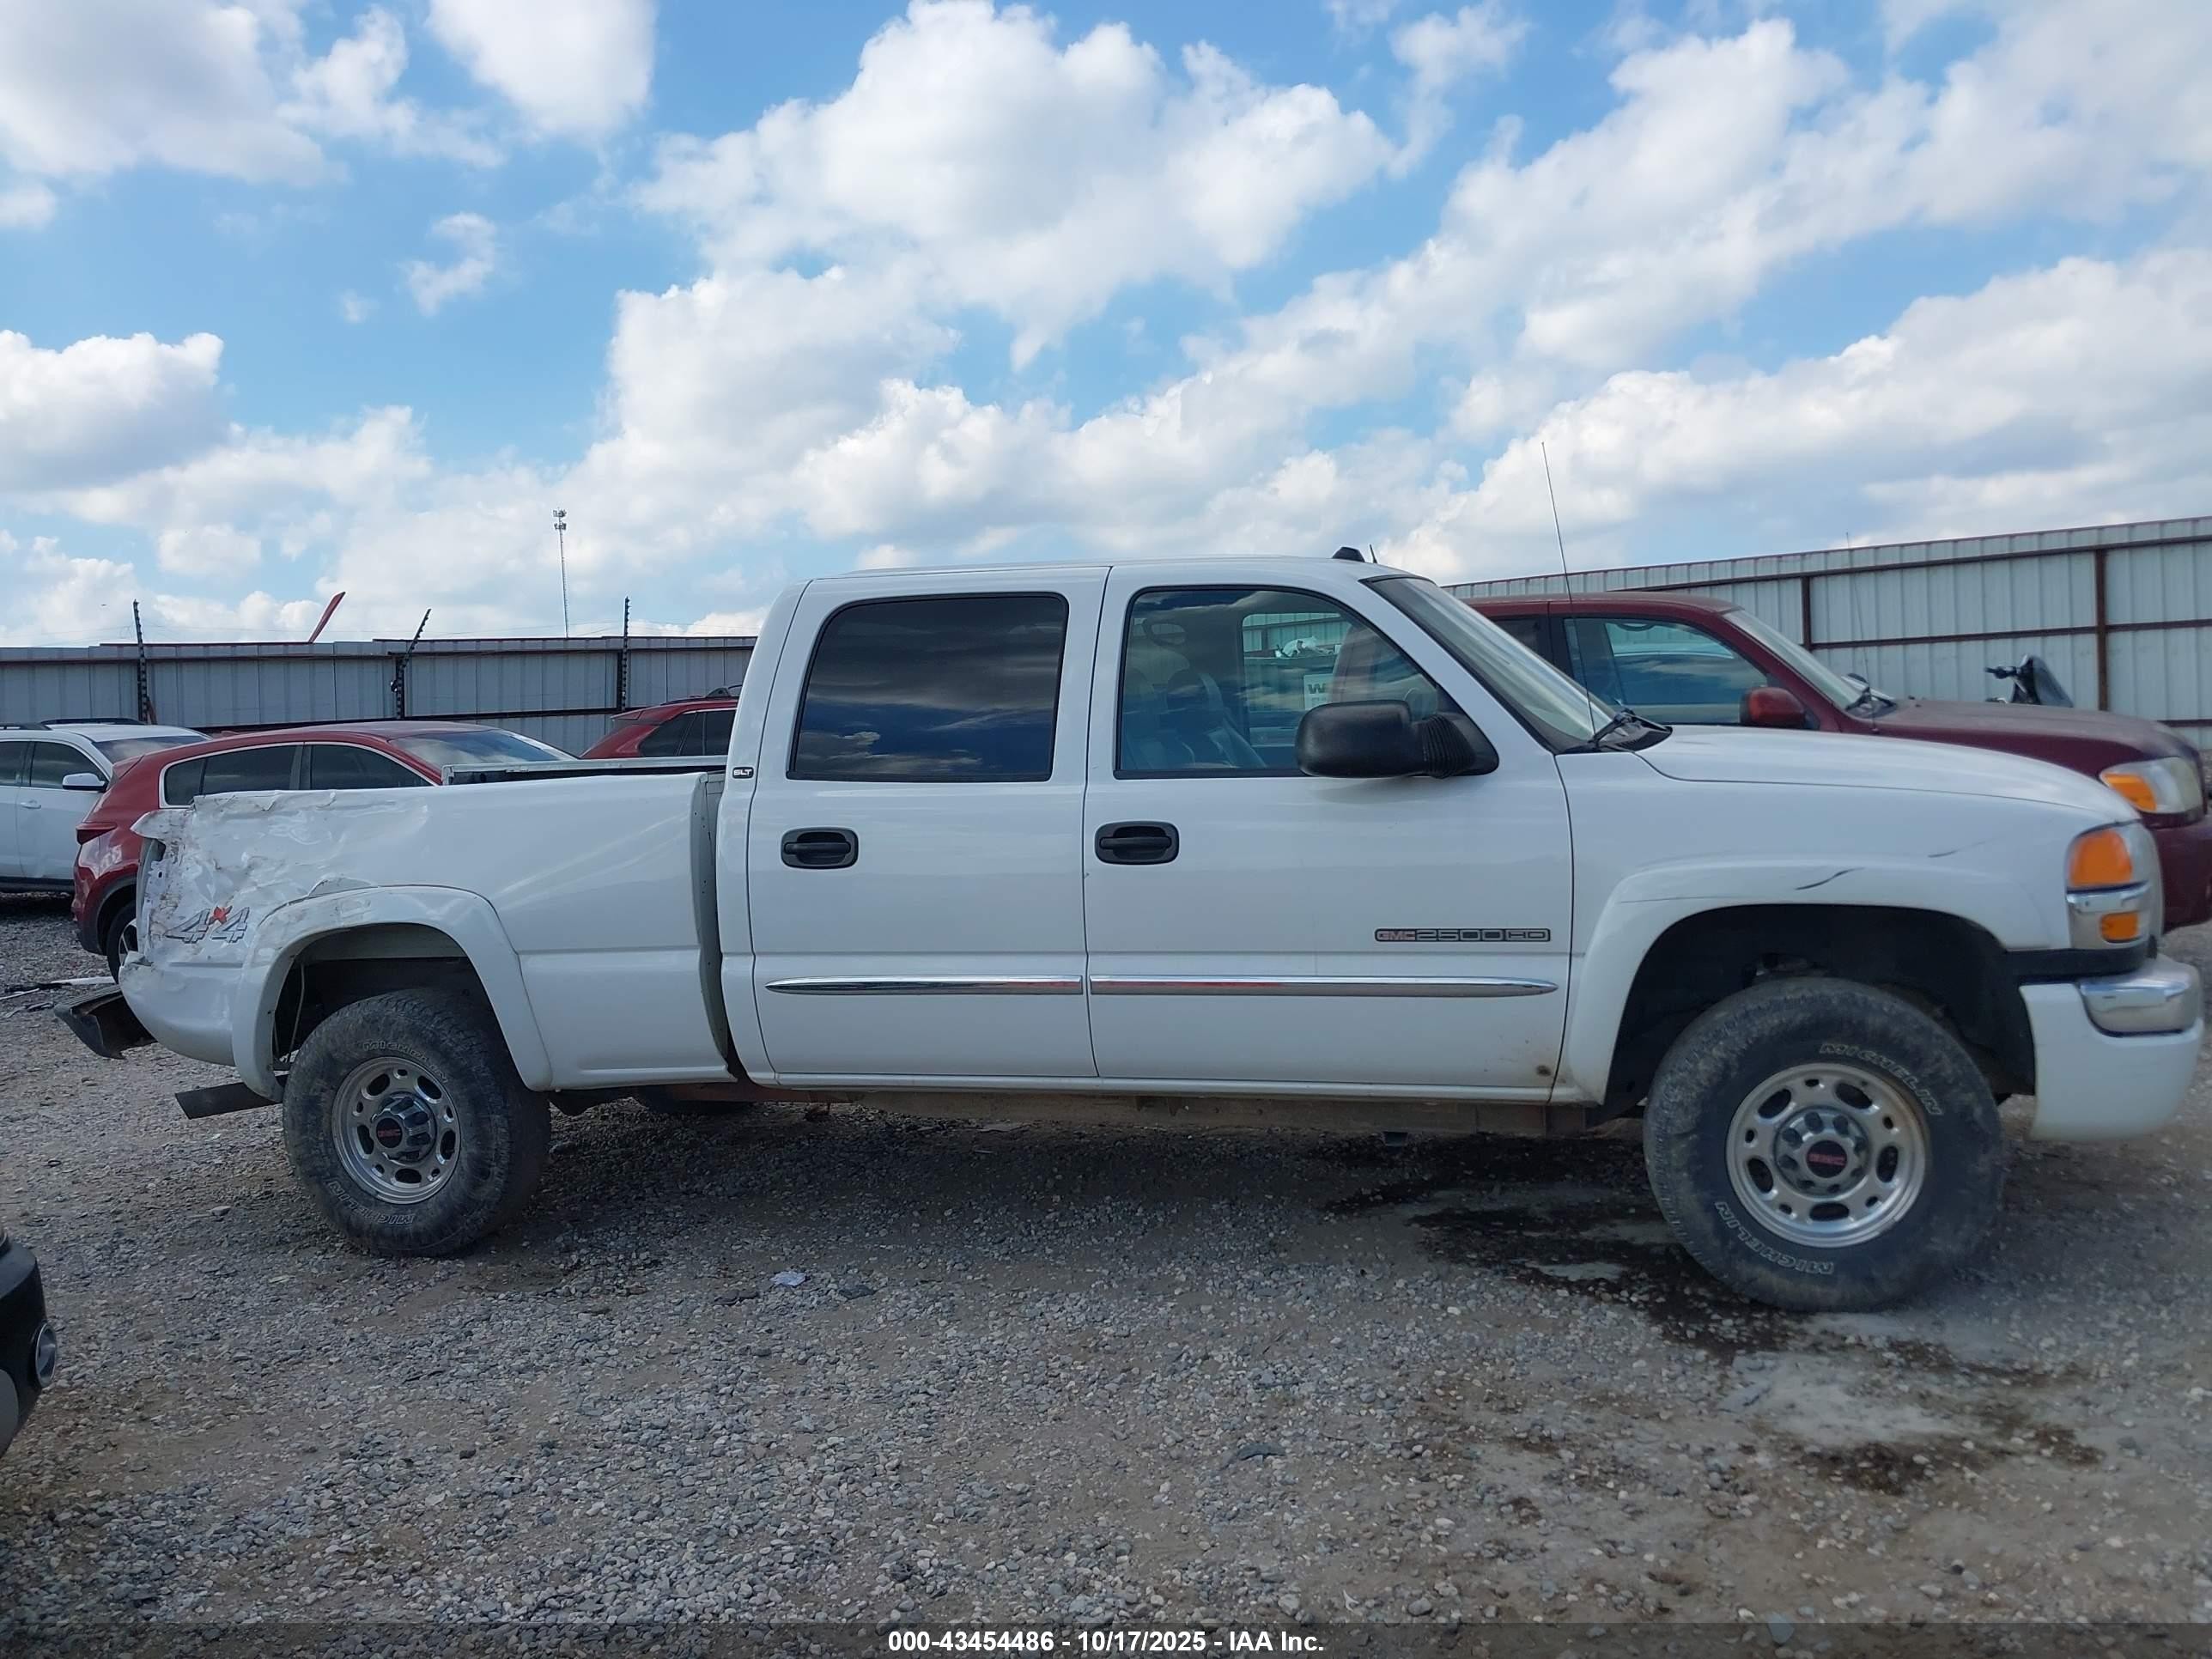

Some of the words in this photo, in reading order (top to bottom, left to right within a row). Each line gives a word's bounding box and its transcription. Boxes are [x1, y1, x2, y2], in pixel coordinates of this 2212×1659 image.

[1376, 930, 1416, 941] GMC
[1819, 1043, 1942, 1115] MICHELIN
[1714, 1201, 1834, 1274] MICHELIN
